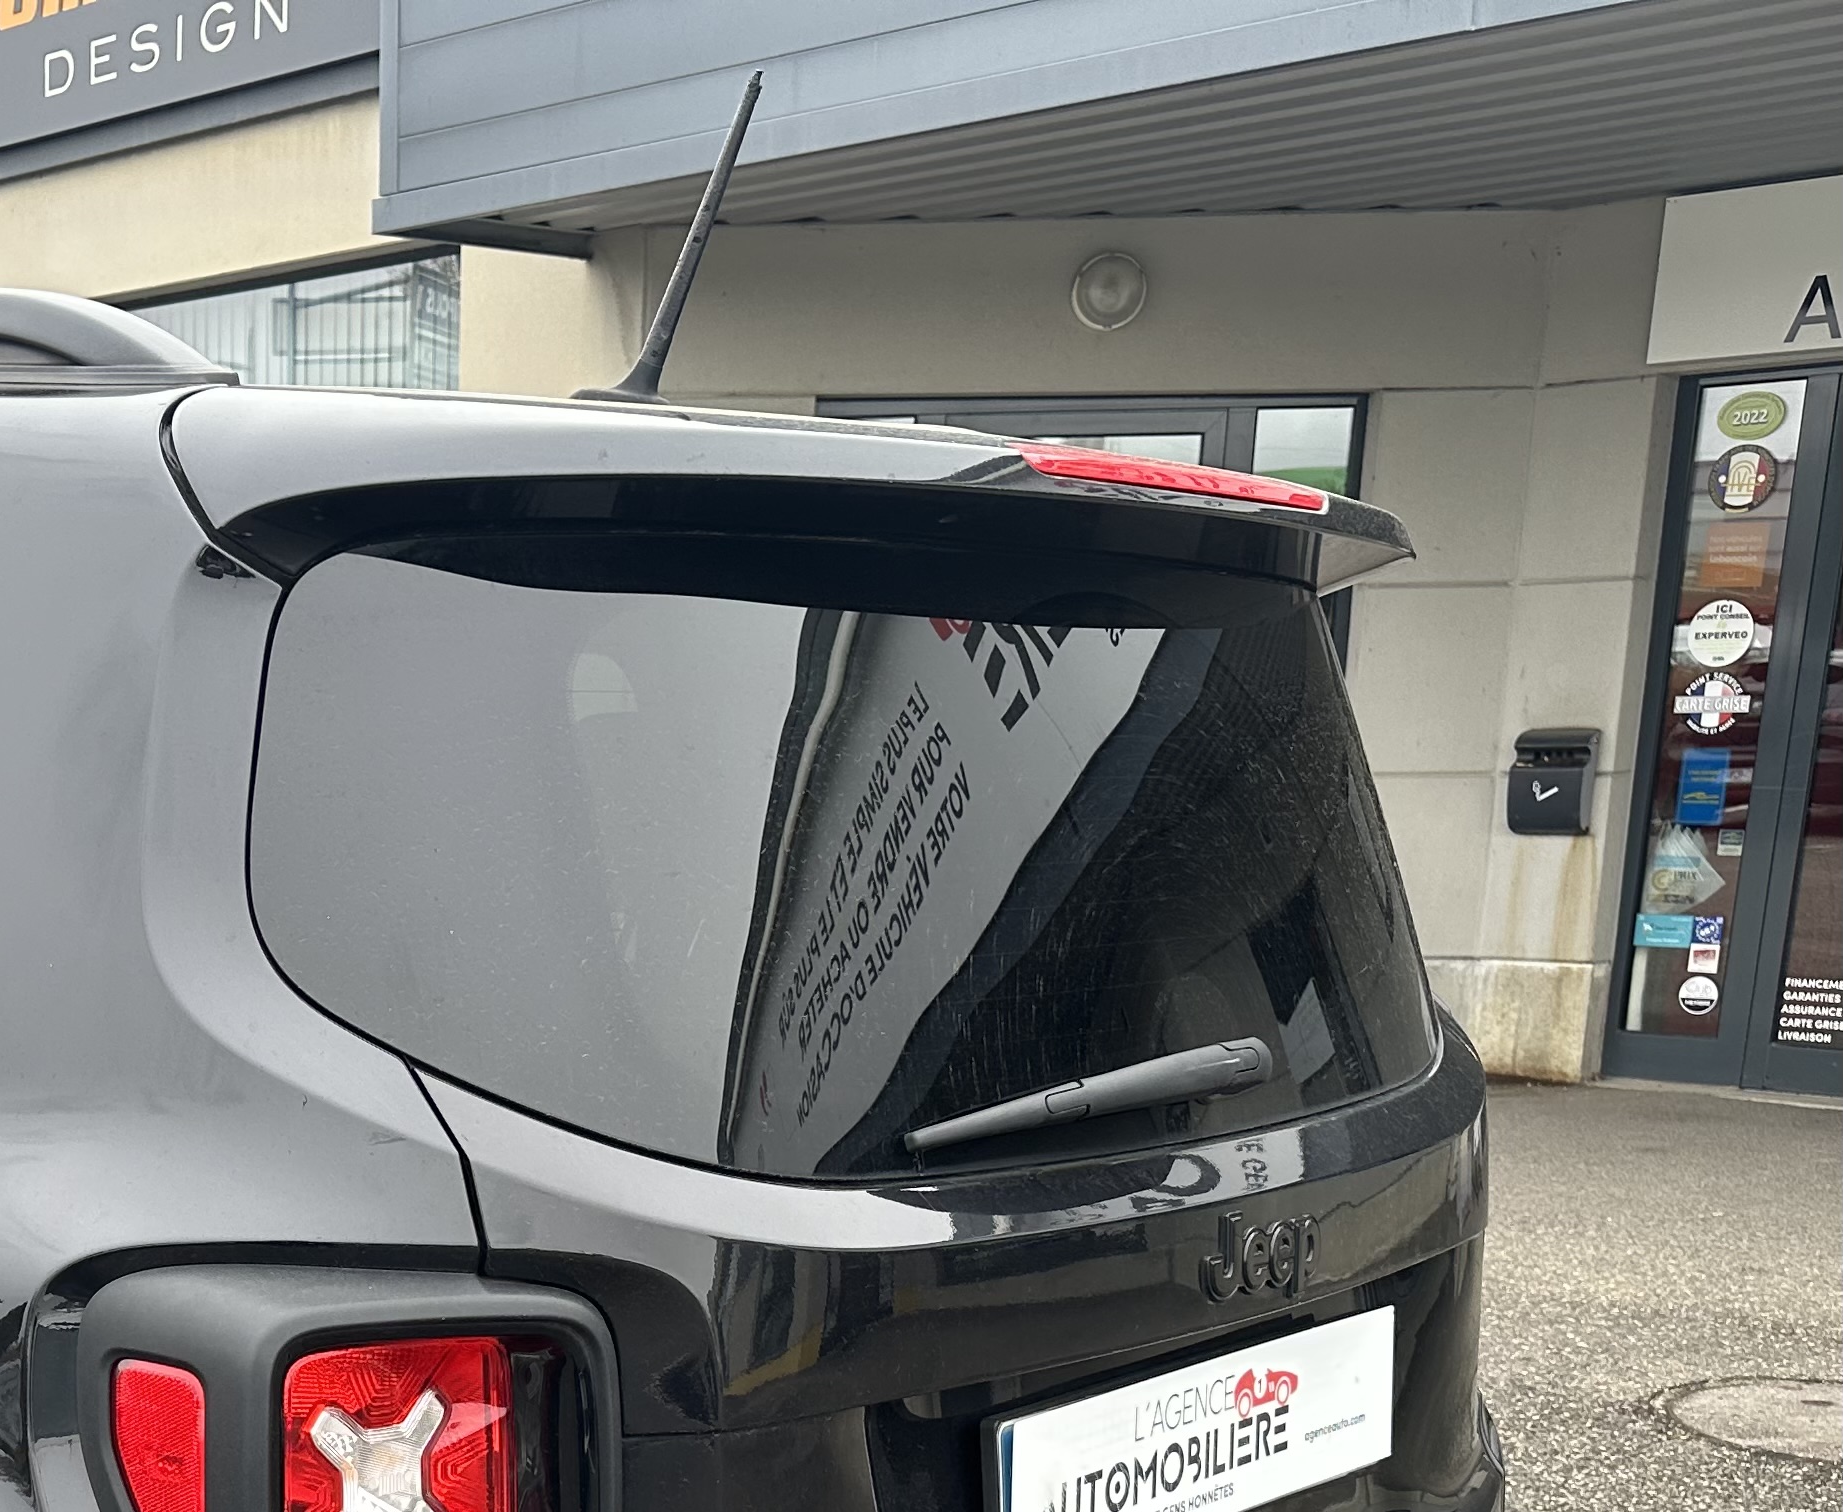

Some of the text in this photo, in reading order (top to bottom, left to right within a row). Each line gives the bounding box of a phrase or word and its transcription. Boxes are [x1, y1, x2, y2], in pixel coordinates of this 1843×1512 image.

[44, 0, 289, 98] DESIGN
[1732, 408, 1769, 426] 2022
[1716, 604, 1733, 614] ICI
[1694, 631, 1748, 640] EXPERVEO
[1674, 697, 1749, 712] CARTE GRISE
[1782, 990, 1842, 1003] GARANTIES
[1780, 1003, 1843, 1017] ASSURANCE
[1779, 1017, 1814, 1028] CARTE
[1777, 1029, 1832, 1044] LIVRAISON
[1199, 1210, 1320, 1303] Jeep
[1134, 1374, 1236, 1443] L'AGENCE
[1188, 1482, 1235, 1512] HONNÊTES
